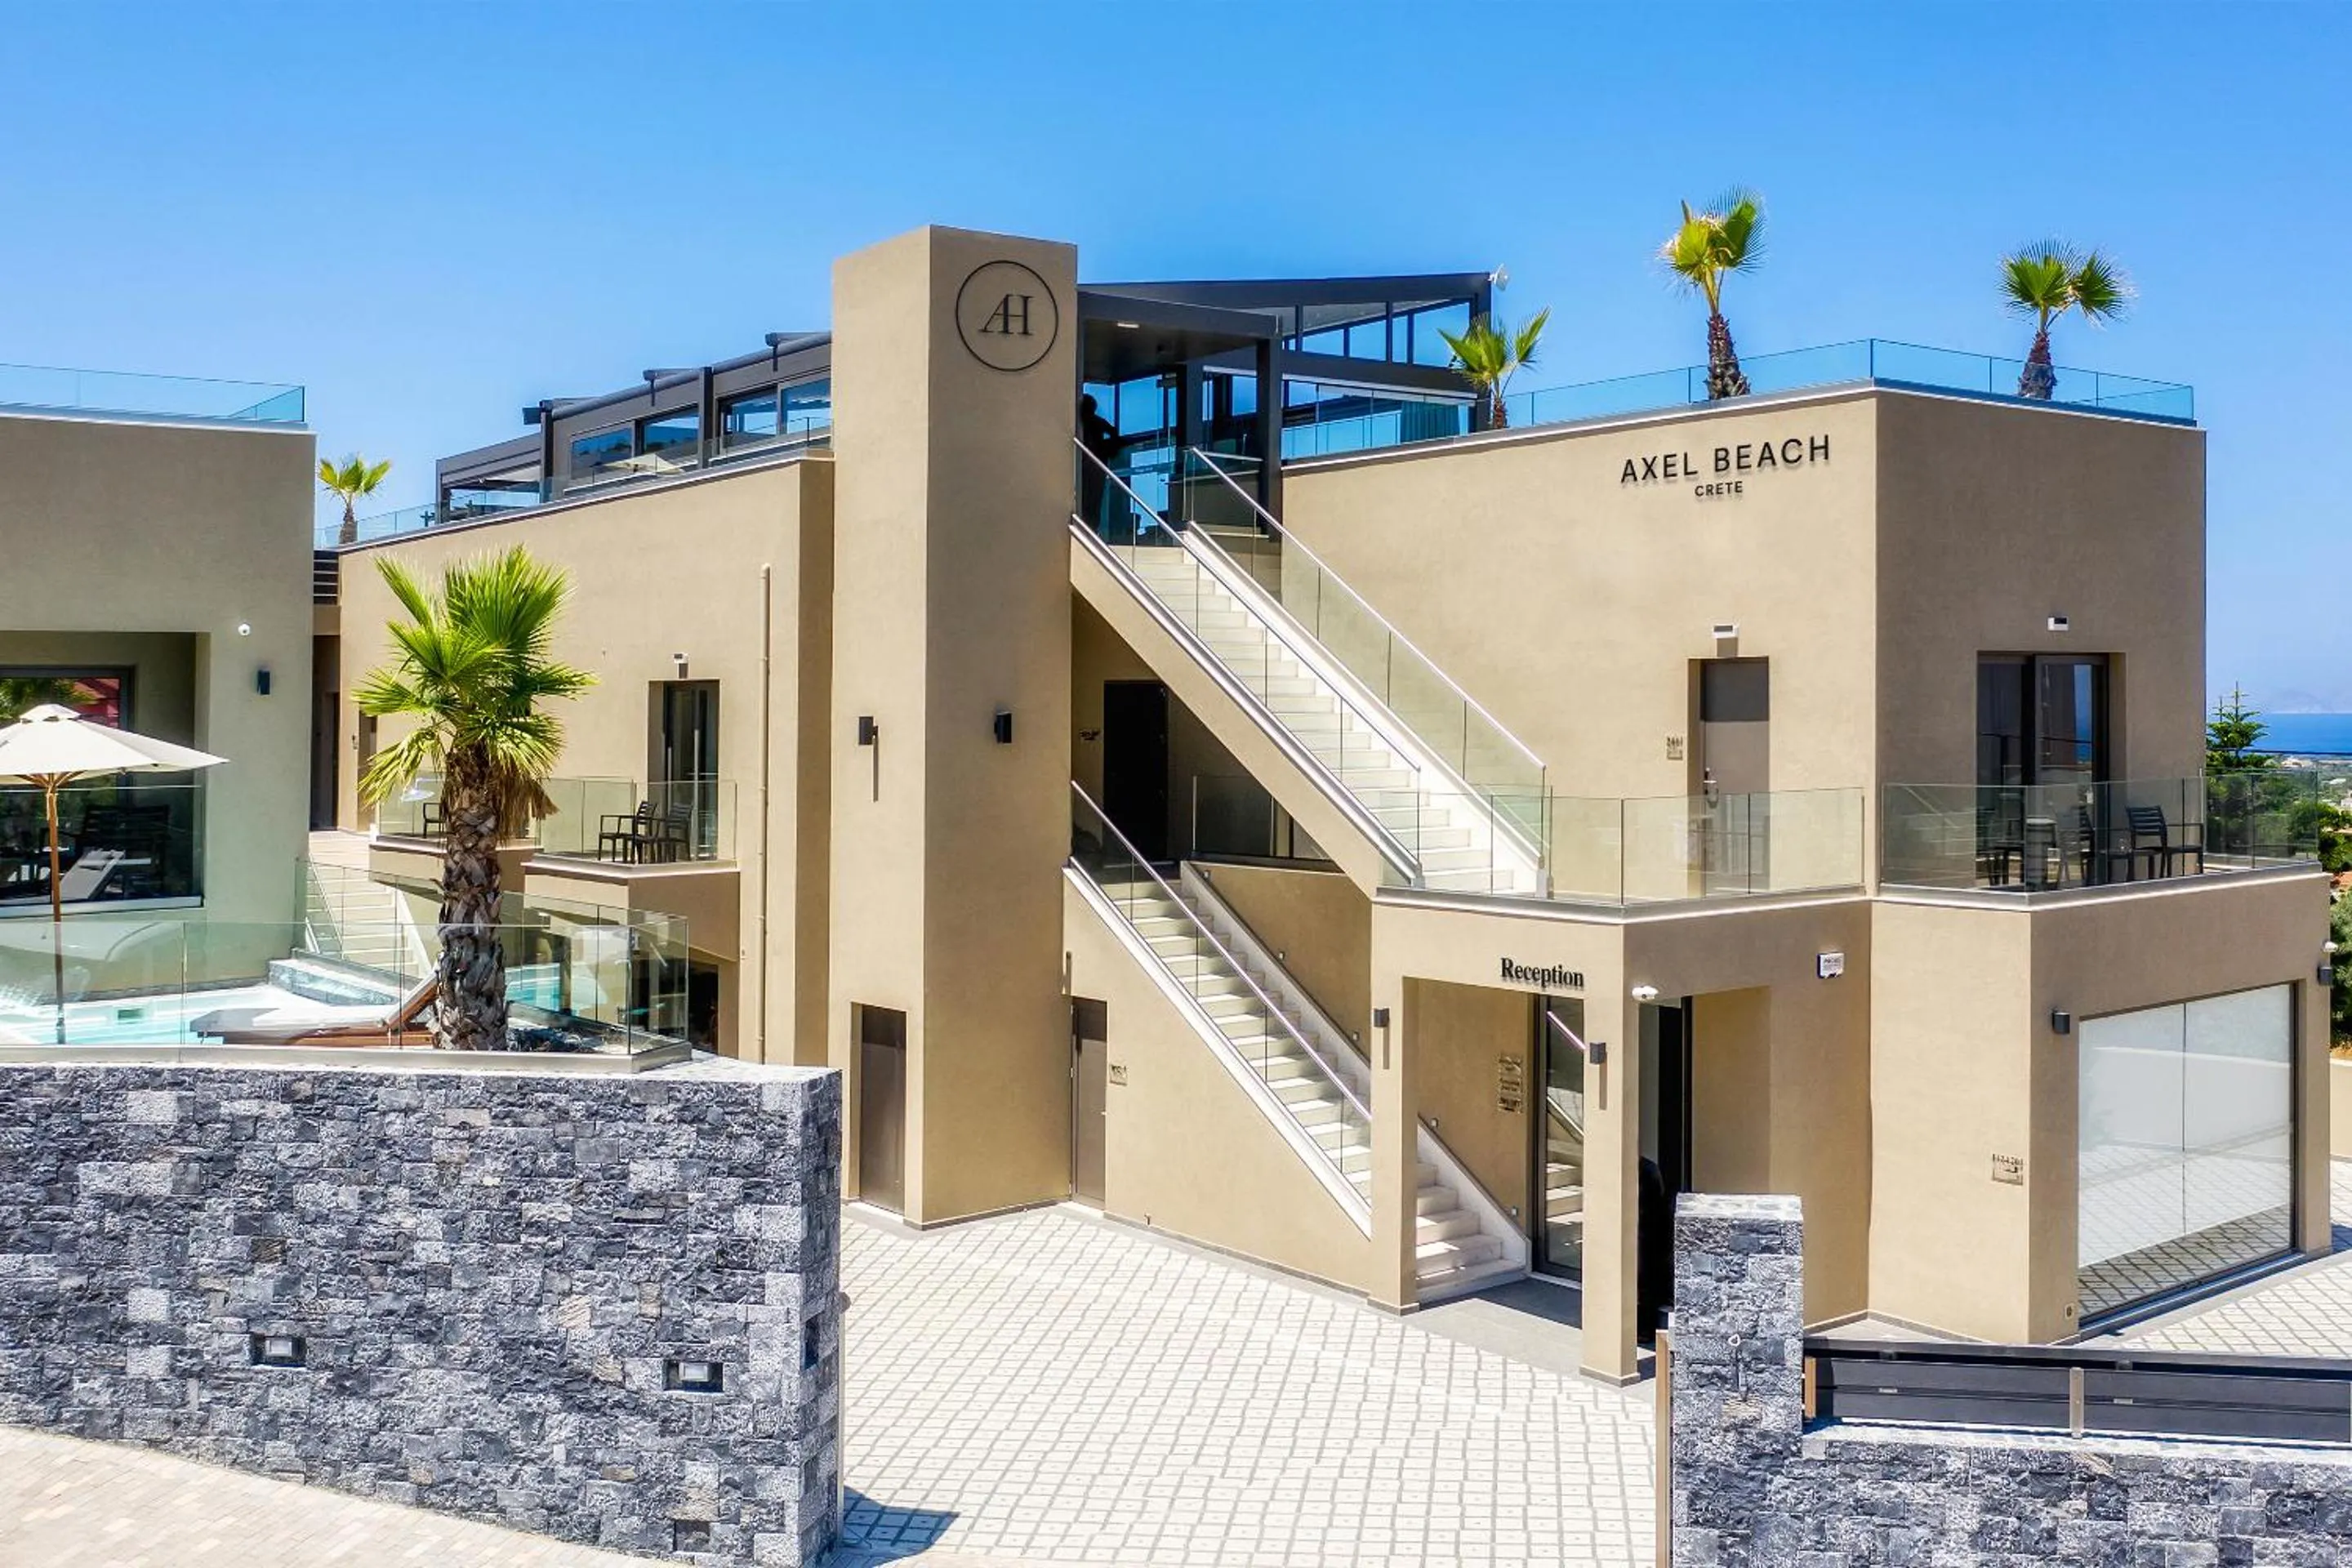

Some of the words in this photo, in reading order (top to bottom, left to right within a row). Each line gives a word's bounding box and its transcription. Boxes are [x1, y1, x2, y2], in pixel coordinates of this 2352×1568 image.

[1621, 452, 1698, 483] AXEL
[1714, 434, 1829, 472] BEACH
[1695, 481, 1743, 497] CRETE
[1500, 957, 1584, 988] Reception
